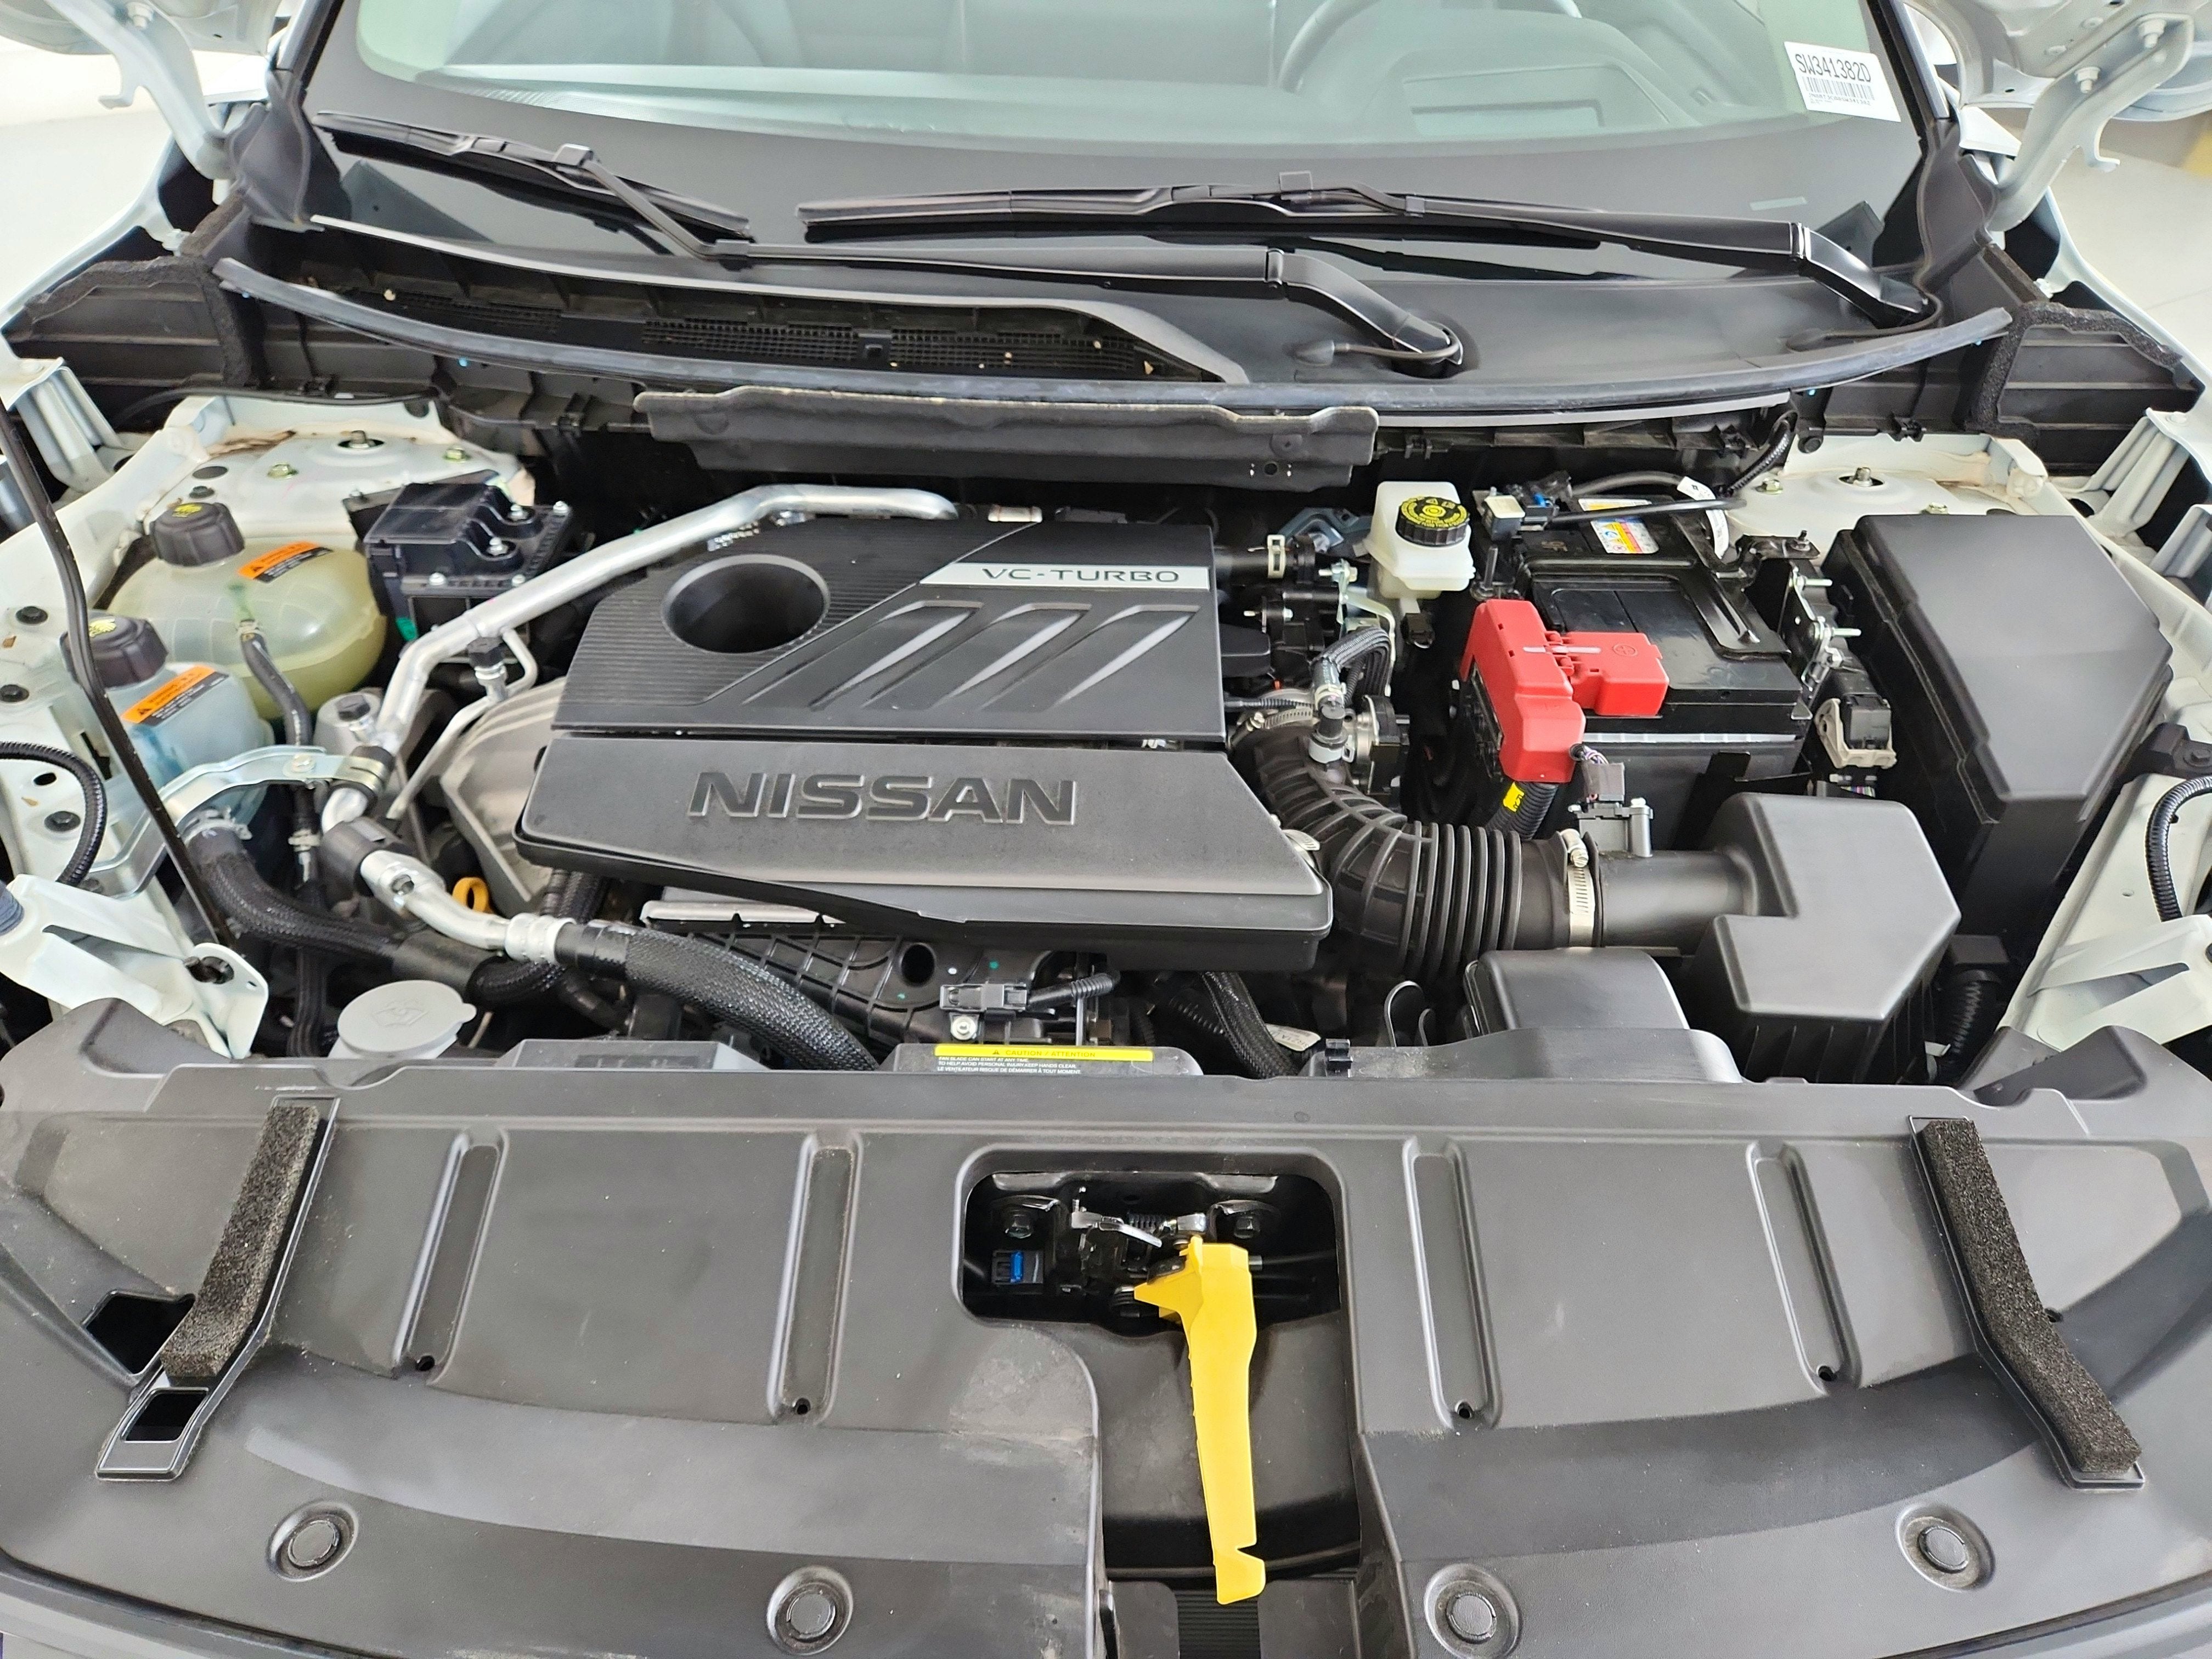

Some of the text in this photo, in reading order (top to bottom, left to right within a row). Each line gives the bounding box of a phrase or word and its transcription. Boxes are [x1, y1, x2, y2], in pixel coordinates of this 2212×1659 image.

[1795, 54, 1871, 82] SW341382D
[982, 568, 1179, 583] VC-TURBO
[687, 771, 1076, 826] NISSAN
